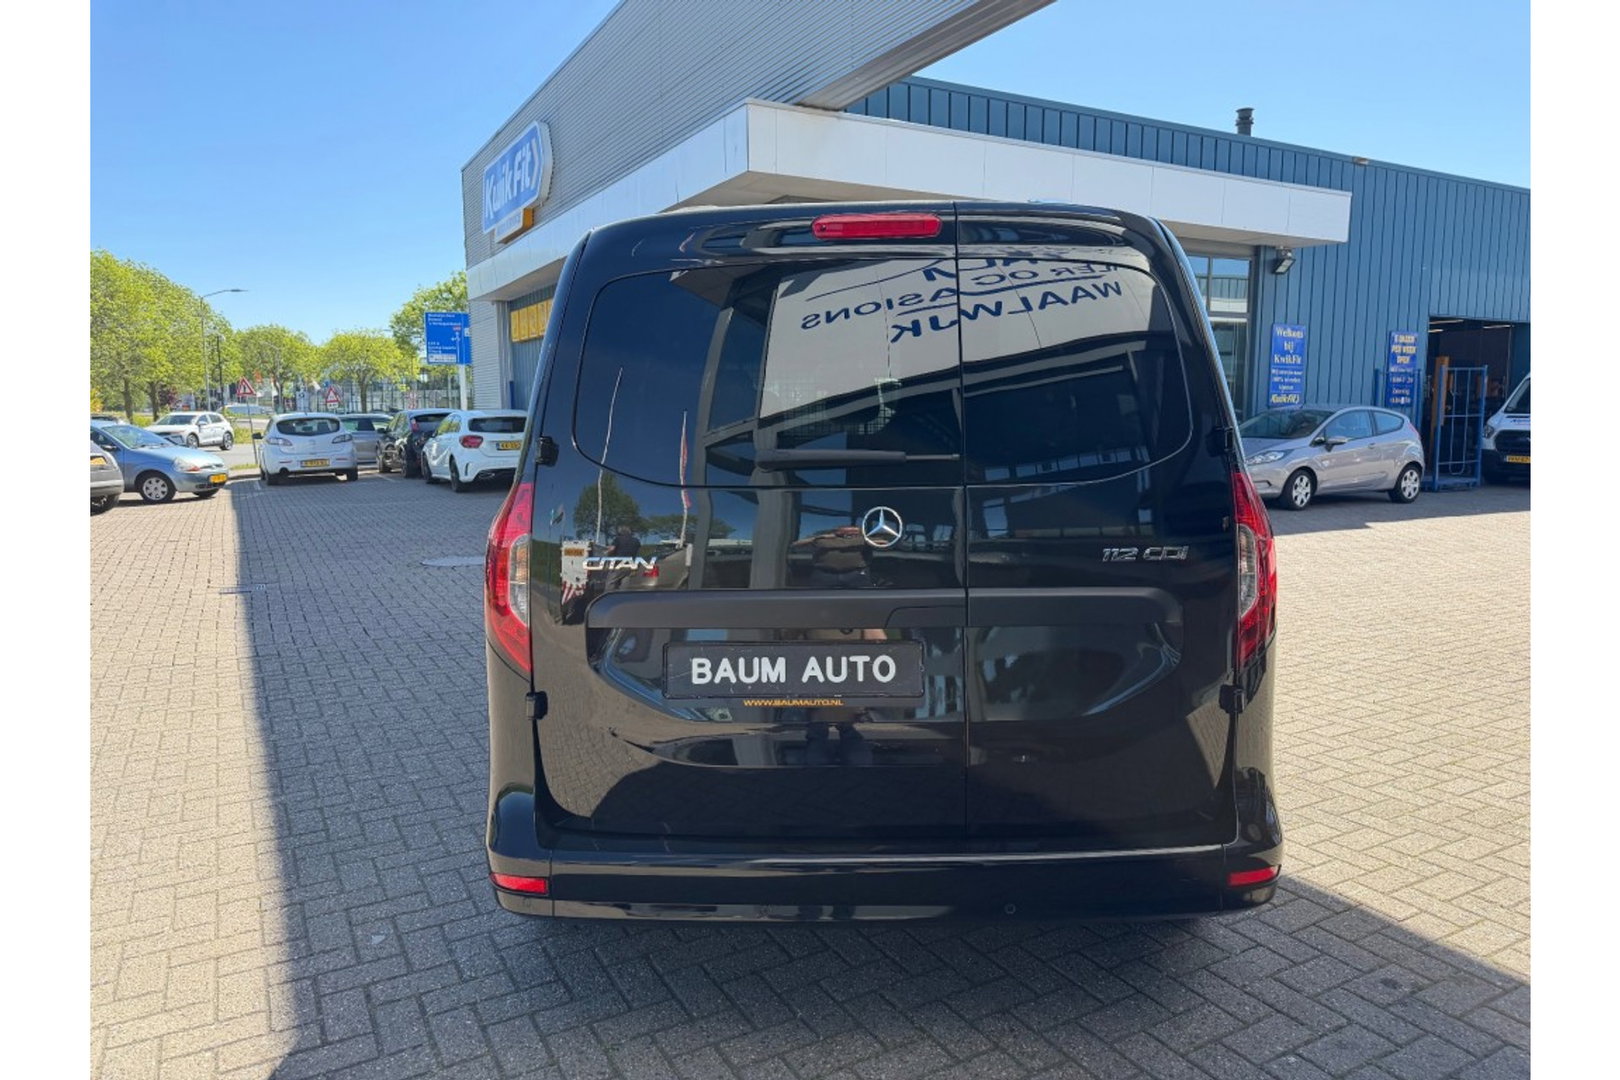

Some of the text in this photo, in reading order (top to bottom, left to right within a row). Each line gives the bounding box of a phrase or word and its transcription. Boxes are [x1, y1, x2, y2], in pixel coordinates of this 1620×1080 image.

[1102, 546, 1189, 562] 112 CDI
[583, 556, 657, 570] CITAN
[692, 655, 896, 684] BAUM AUTO
